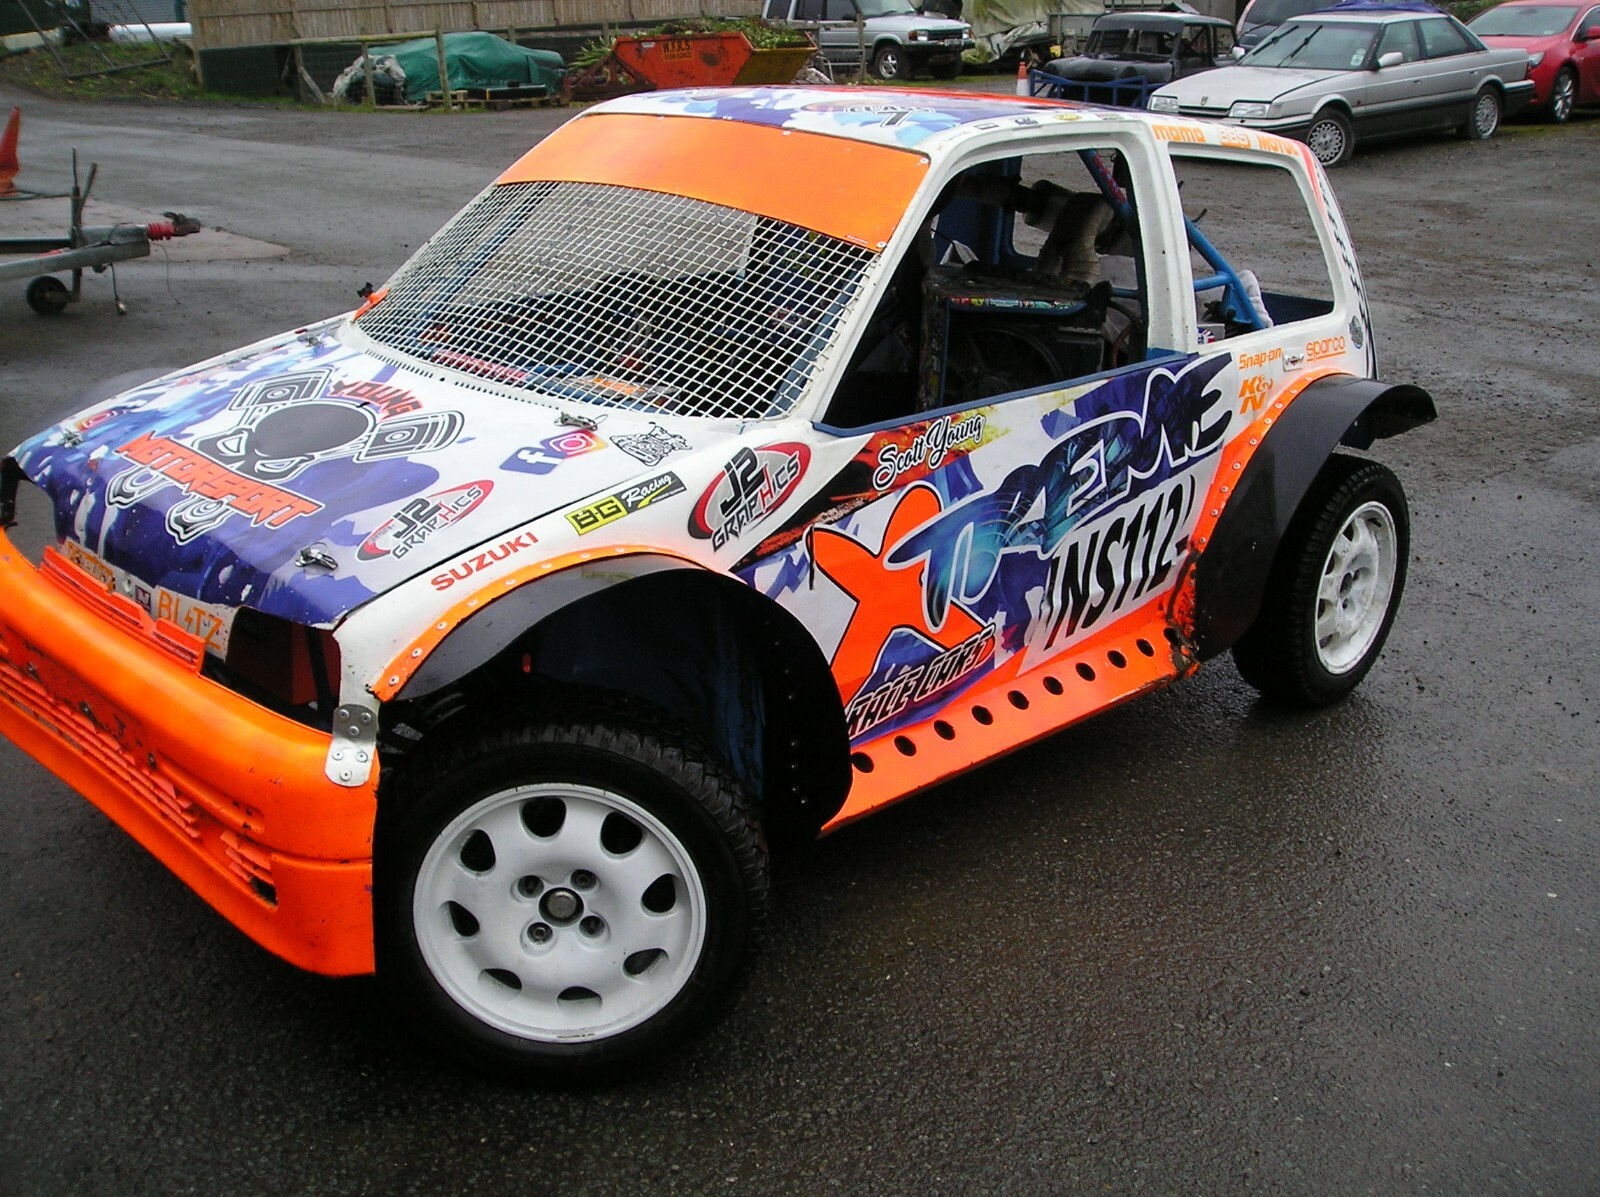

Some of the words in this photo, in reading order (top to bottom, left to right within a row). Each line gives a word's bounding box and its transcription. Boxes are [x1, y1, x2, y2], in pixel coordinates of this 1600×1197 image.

[1239, 347, 1282, 370] Snap-on
[1306, 335, 1346, 361] sparco
[328, 380, 424, 421] YOUNG
[115, 430, 324, 528] MOTORSPORT
[719, 446, 766, 517] J2
[873, 436, 927, 490] Scott
[925, 414, 985, 469] Young
[393, 497, 442, 538] J2
[621, 475, 672, 508] Racing
[712, 452, 800, 552] GRAPHICS
[391, 487, 482, 560] GRAPHICS
[431, 531, 539, 591] SUZUKI
